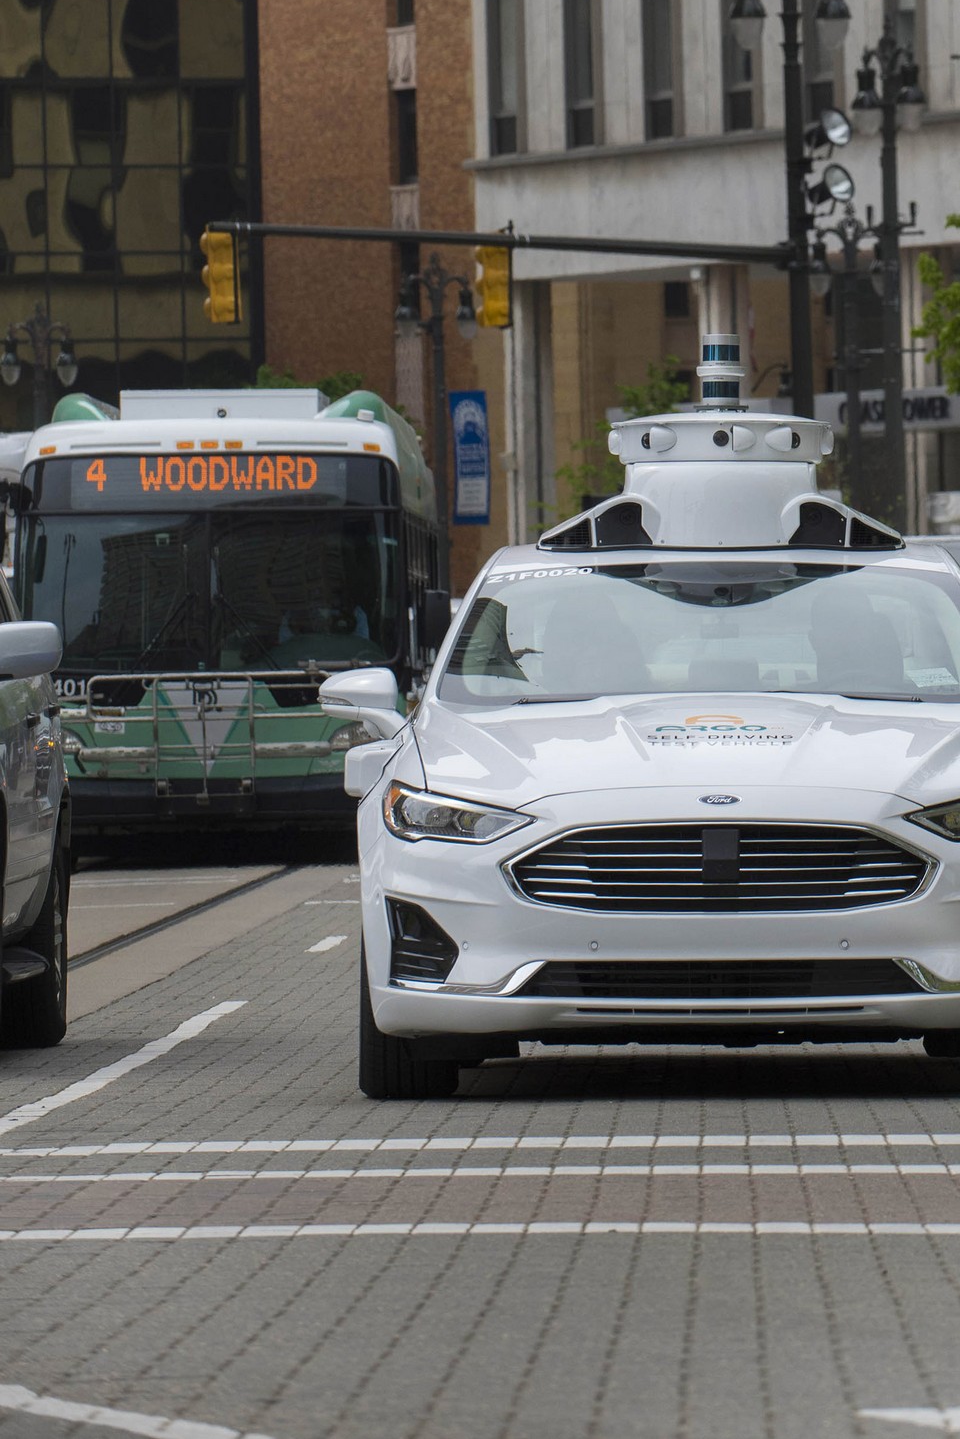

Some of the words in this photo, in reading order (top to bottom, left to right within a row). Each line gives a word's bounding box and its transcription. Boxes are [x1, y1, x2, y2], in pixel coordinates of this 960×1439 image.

[838, 400, 886, 424] CAS
[901, 395, 950, 421] OWER
[86, 458, 107, 492] 4
[140, 455, 317, 492] WOODWARD
[486, 567, 593, 584] Z1F0020
[655, 724, 767, 732] ARGO
[707, 795, 733, 804] Ford
